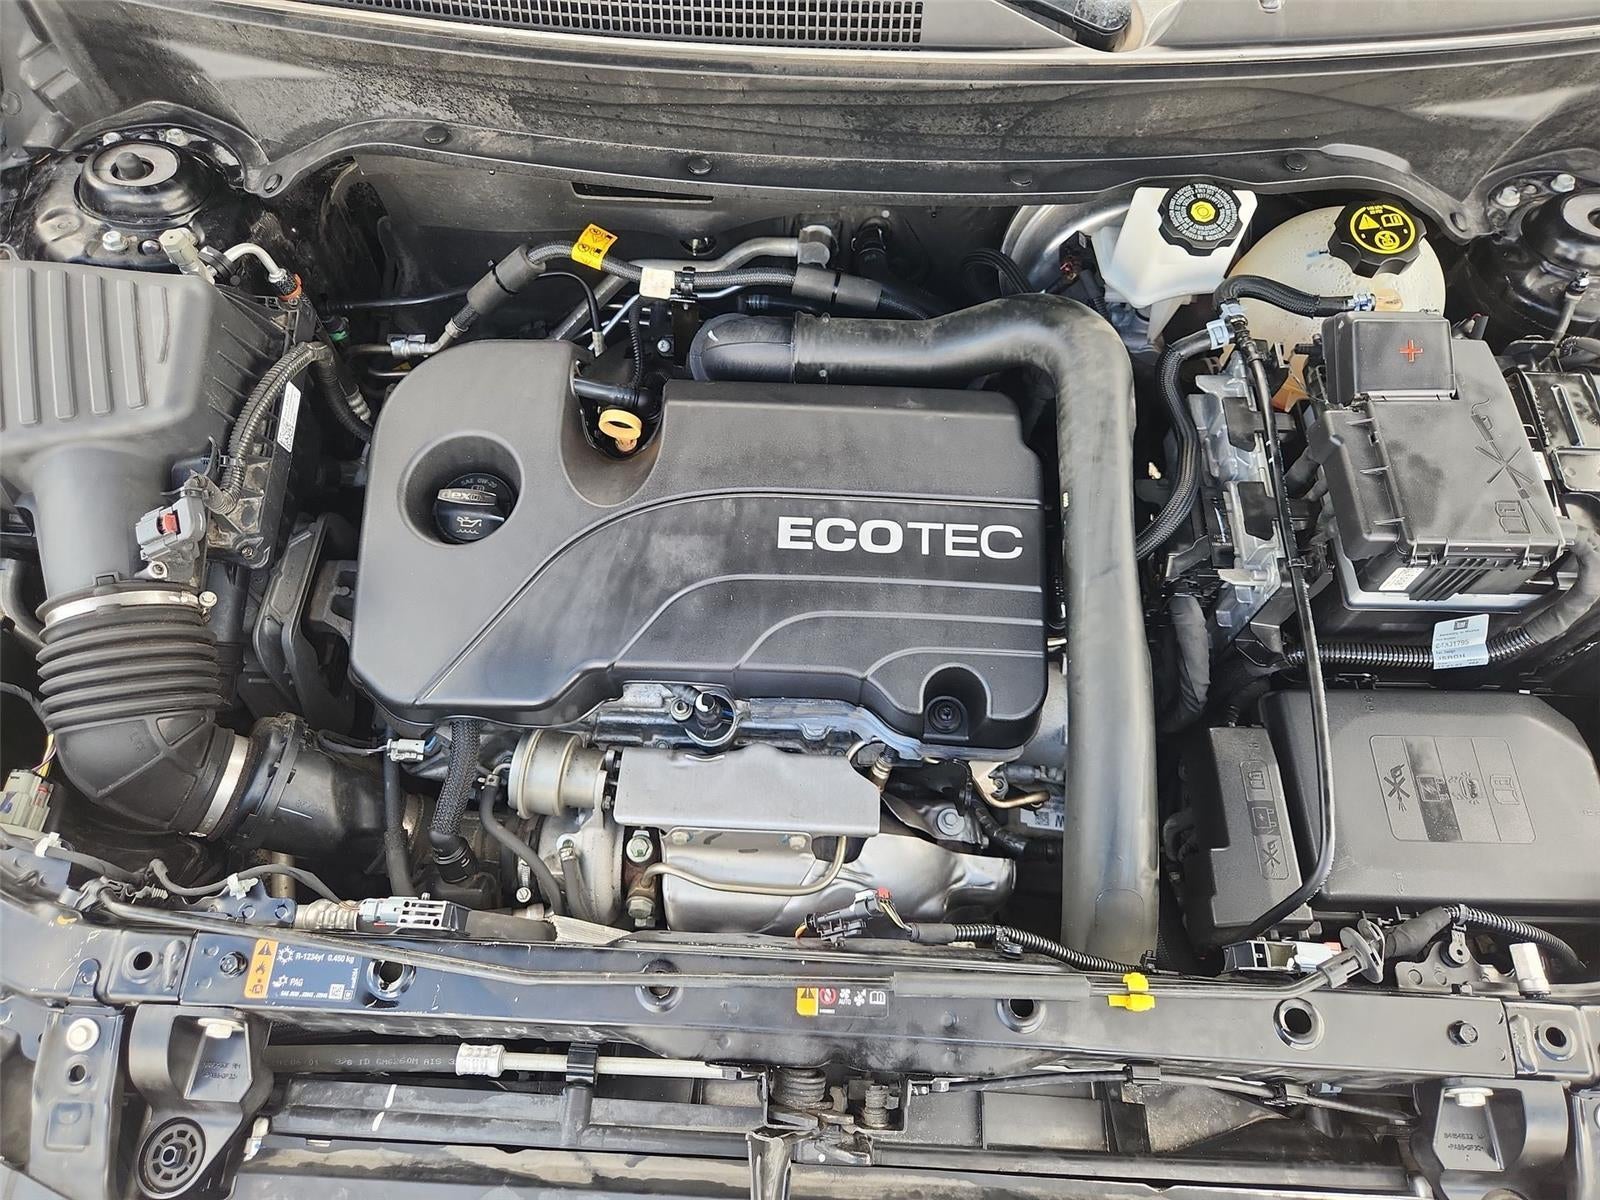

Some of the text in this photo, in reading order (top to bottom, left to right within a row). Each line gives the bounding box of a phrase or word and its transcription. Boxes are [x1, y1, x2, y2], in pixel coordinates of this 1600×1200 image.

[777, 516, 1023, 560] ECOTEC
[295, 952, 355, 964] R-1234yf 0.450 kg
[289, 977, 304, 987] PAG
